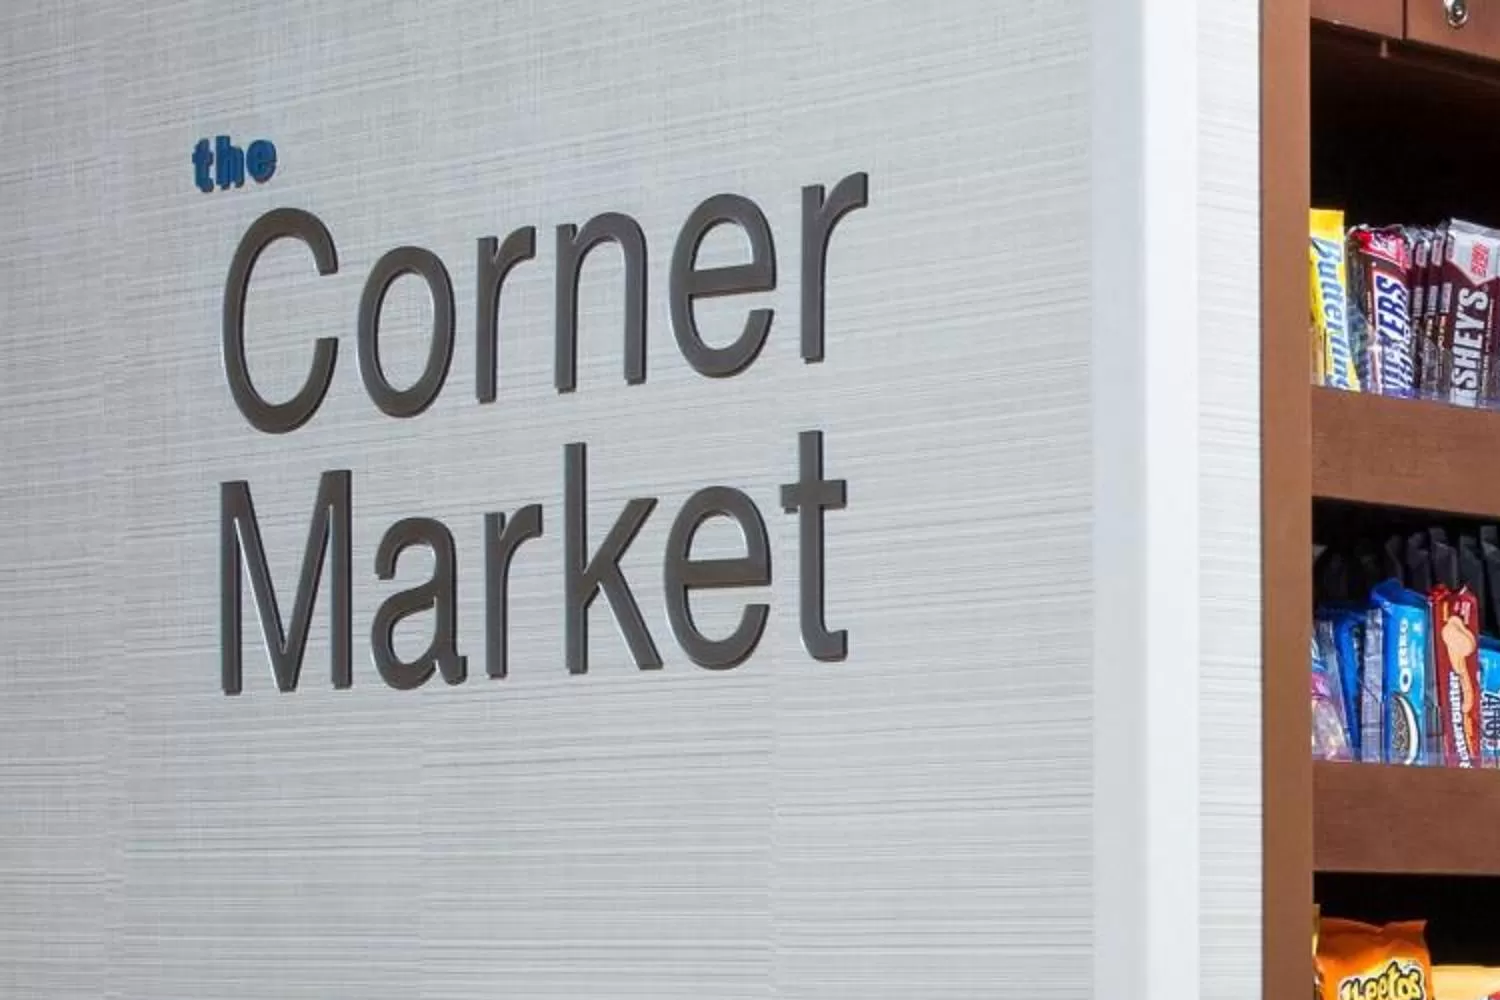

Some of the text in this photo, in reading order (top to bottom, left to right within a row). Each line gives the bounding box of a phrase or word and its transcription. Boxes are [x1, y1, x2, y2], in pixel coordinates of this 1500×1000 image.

[191, 135, 278, 193] the
[222, 171, 869, 435] Corner
[219, 429, 849, 696] Market
